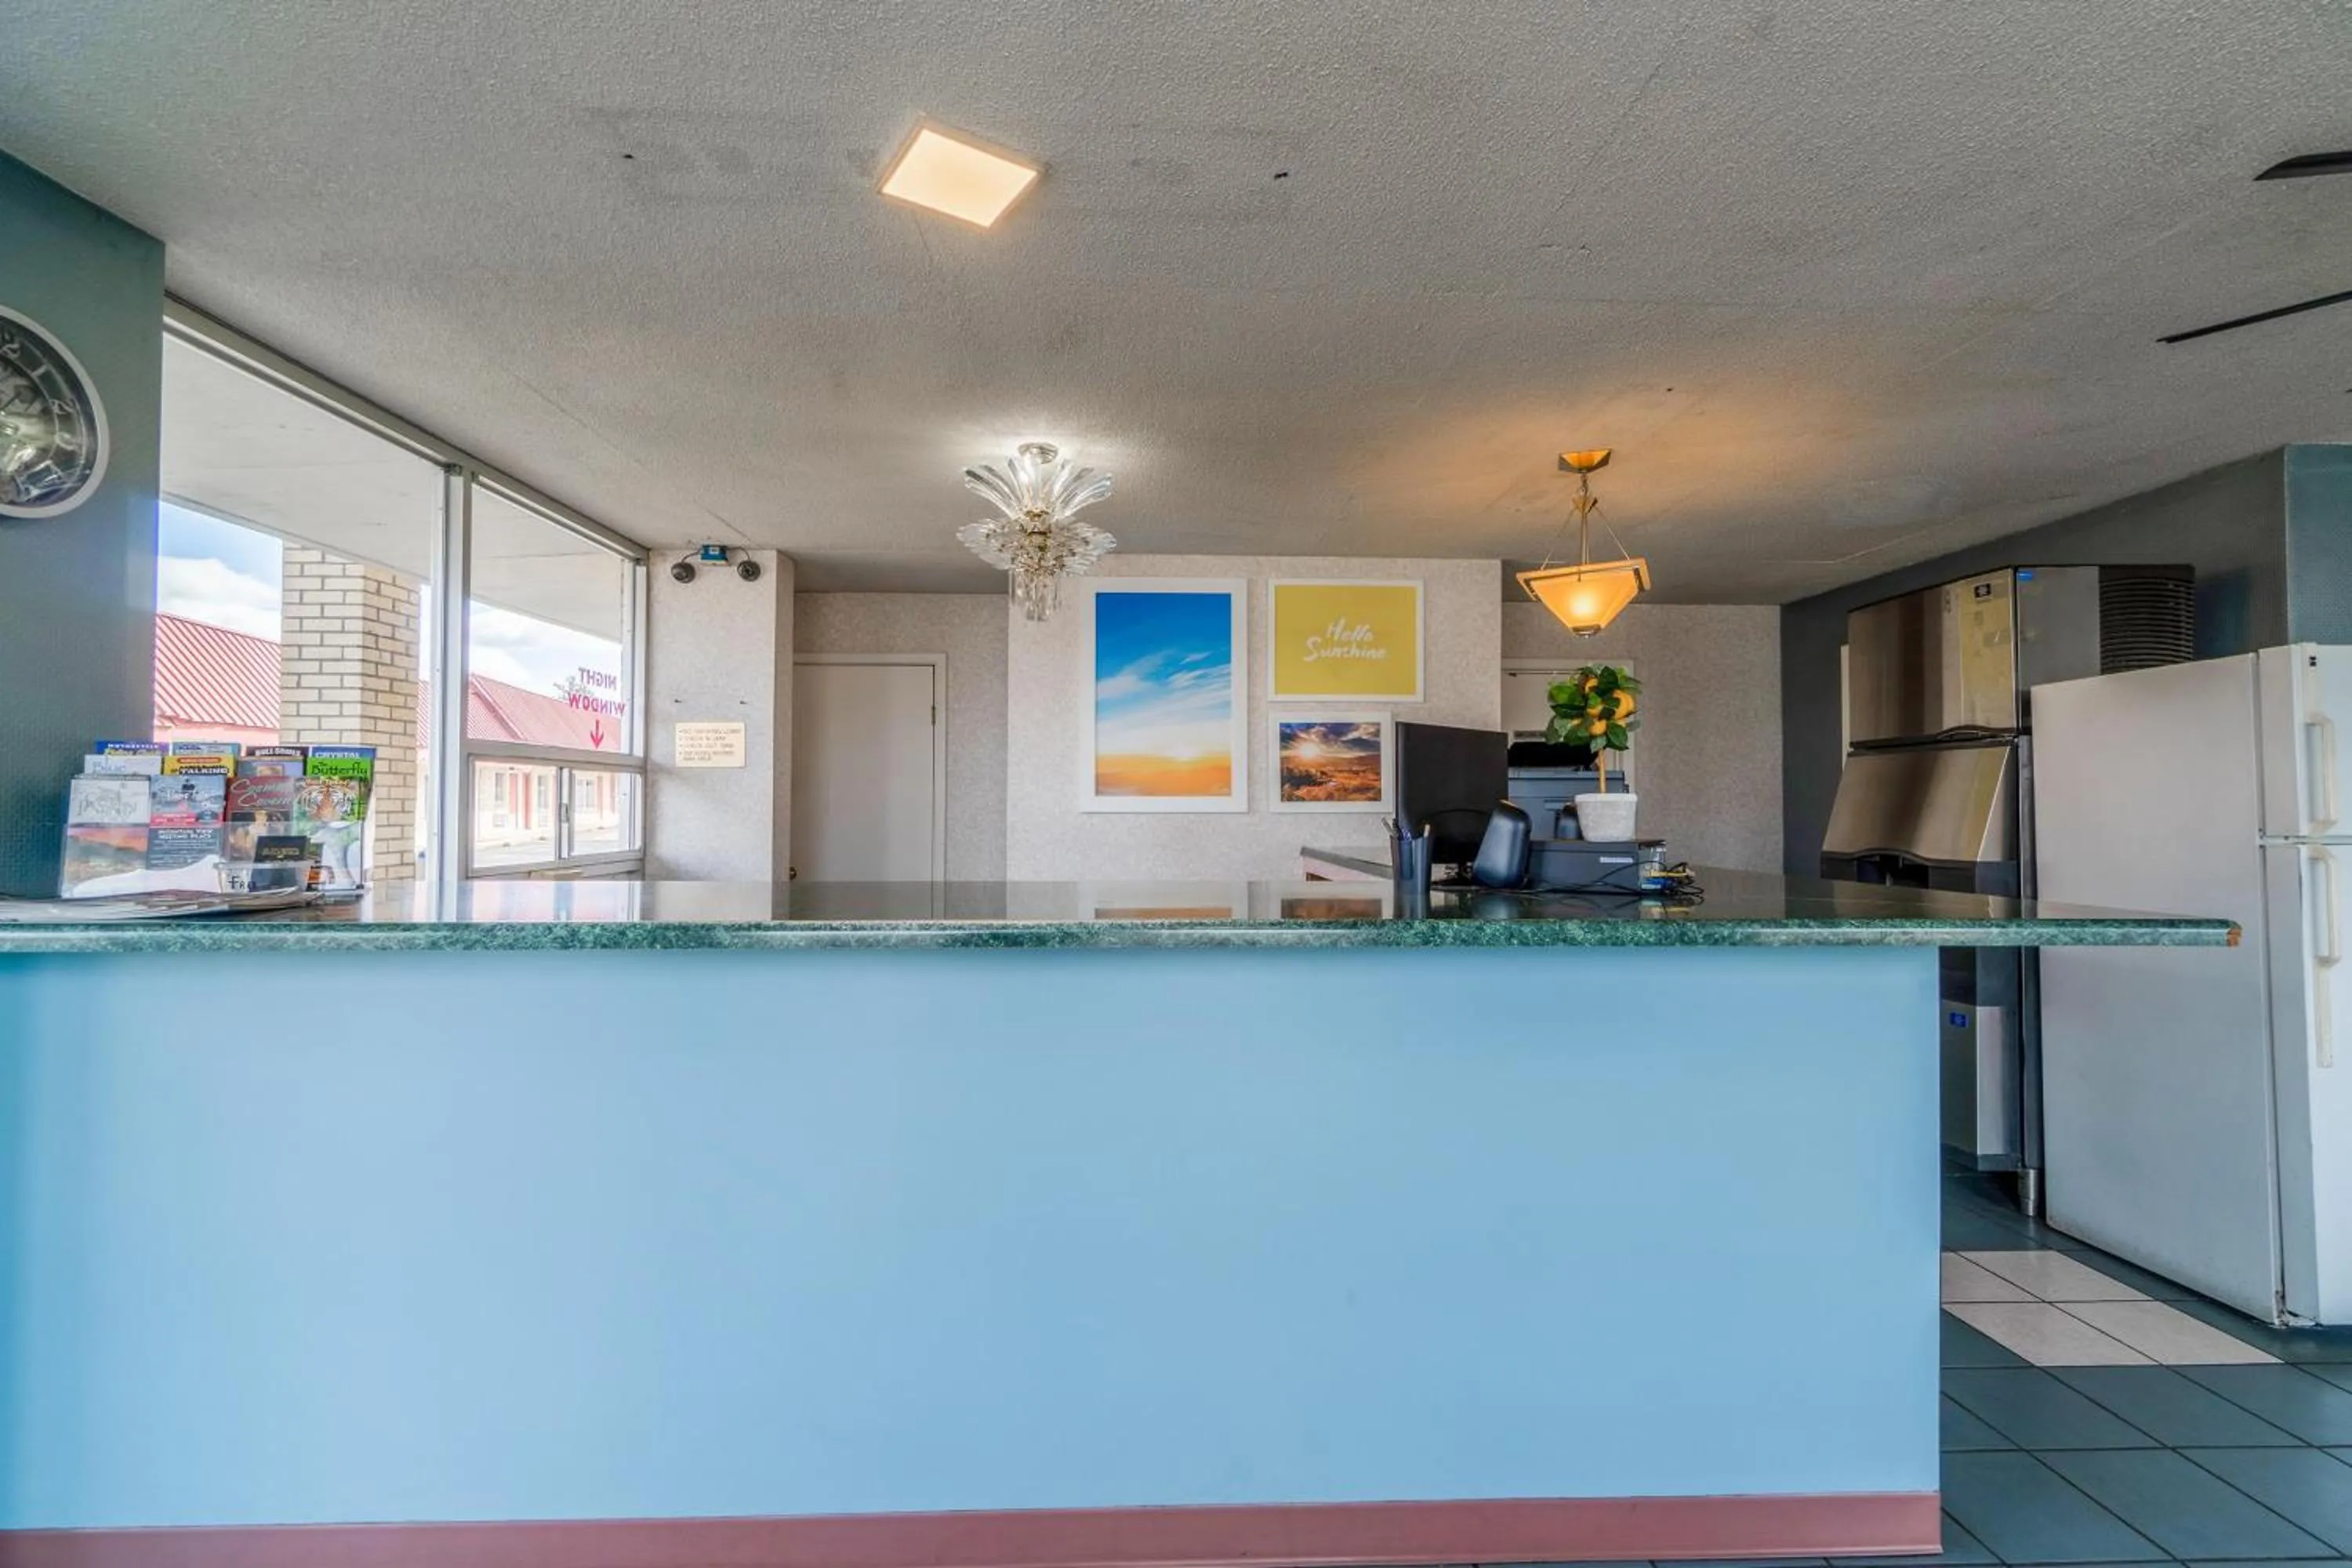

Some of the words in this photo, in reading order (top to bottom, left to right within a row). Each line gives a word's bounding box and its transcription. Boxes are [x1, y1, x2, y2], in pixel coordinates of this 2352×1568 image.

[1326, 617, 1374, 642] Hello
[1303, 636, 1386, 662] Sunshine
[311, 760, 368, 778] Butterfly
